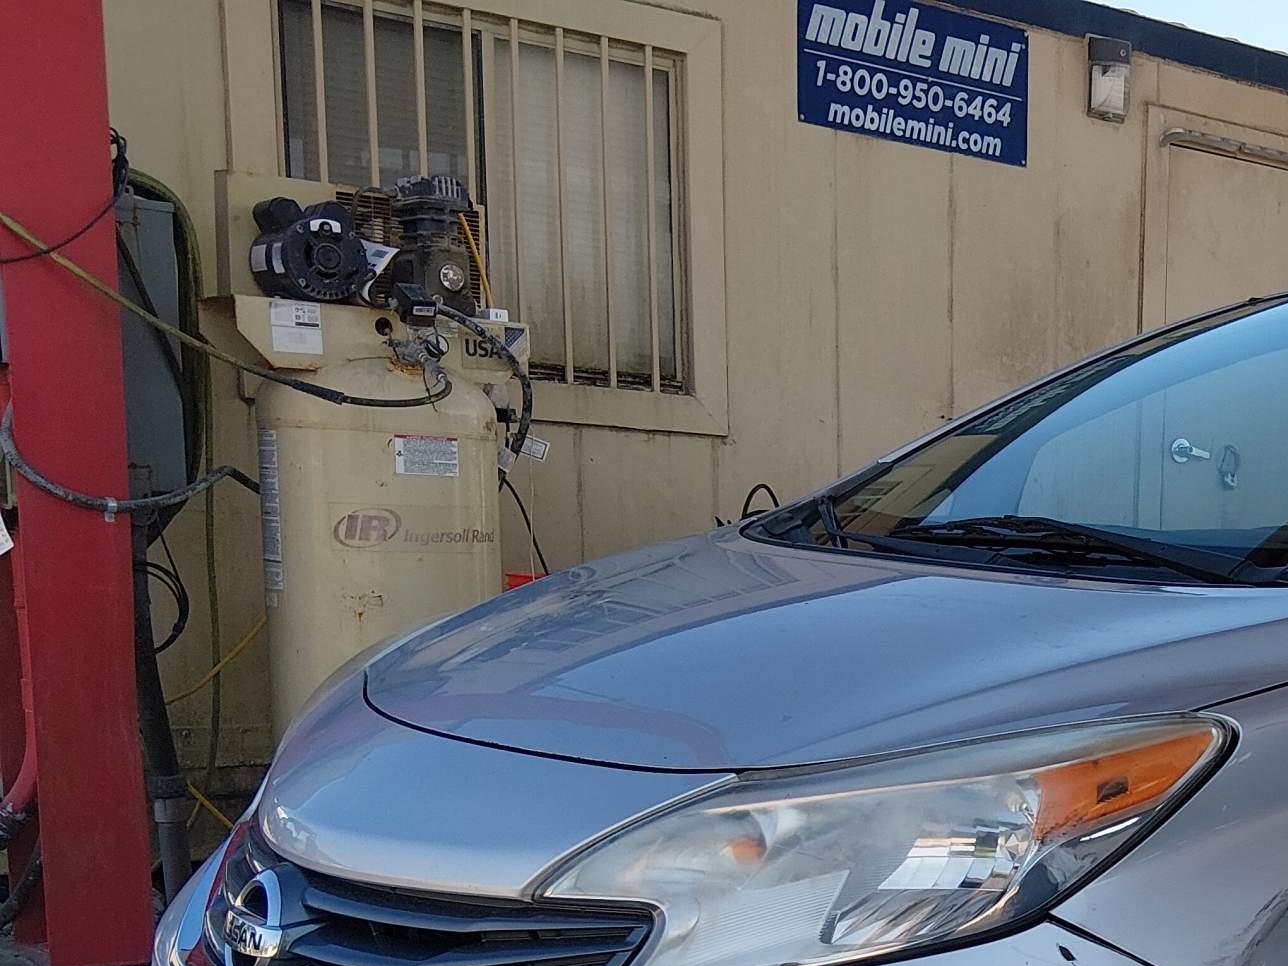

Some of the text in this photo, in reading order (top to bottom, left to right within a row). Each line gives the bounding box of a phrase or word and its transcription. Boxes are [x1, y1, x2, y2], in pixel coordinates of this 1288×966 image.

[804, 0, 1022, 88] mobile mini
[815, 59, 1012, 128] 1-800-950-6464
[827, 102, 1003, 157] mobilemini.com
[403, 528, 495, 546] Ingersoll Rand
